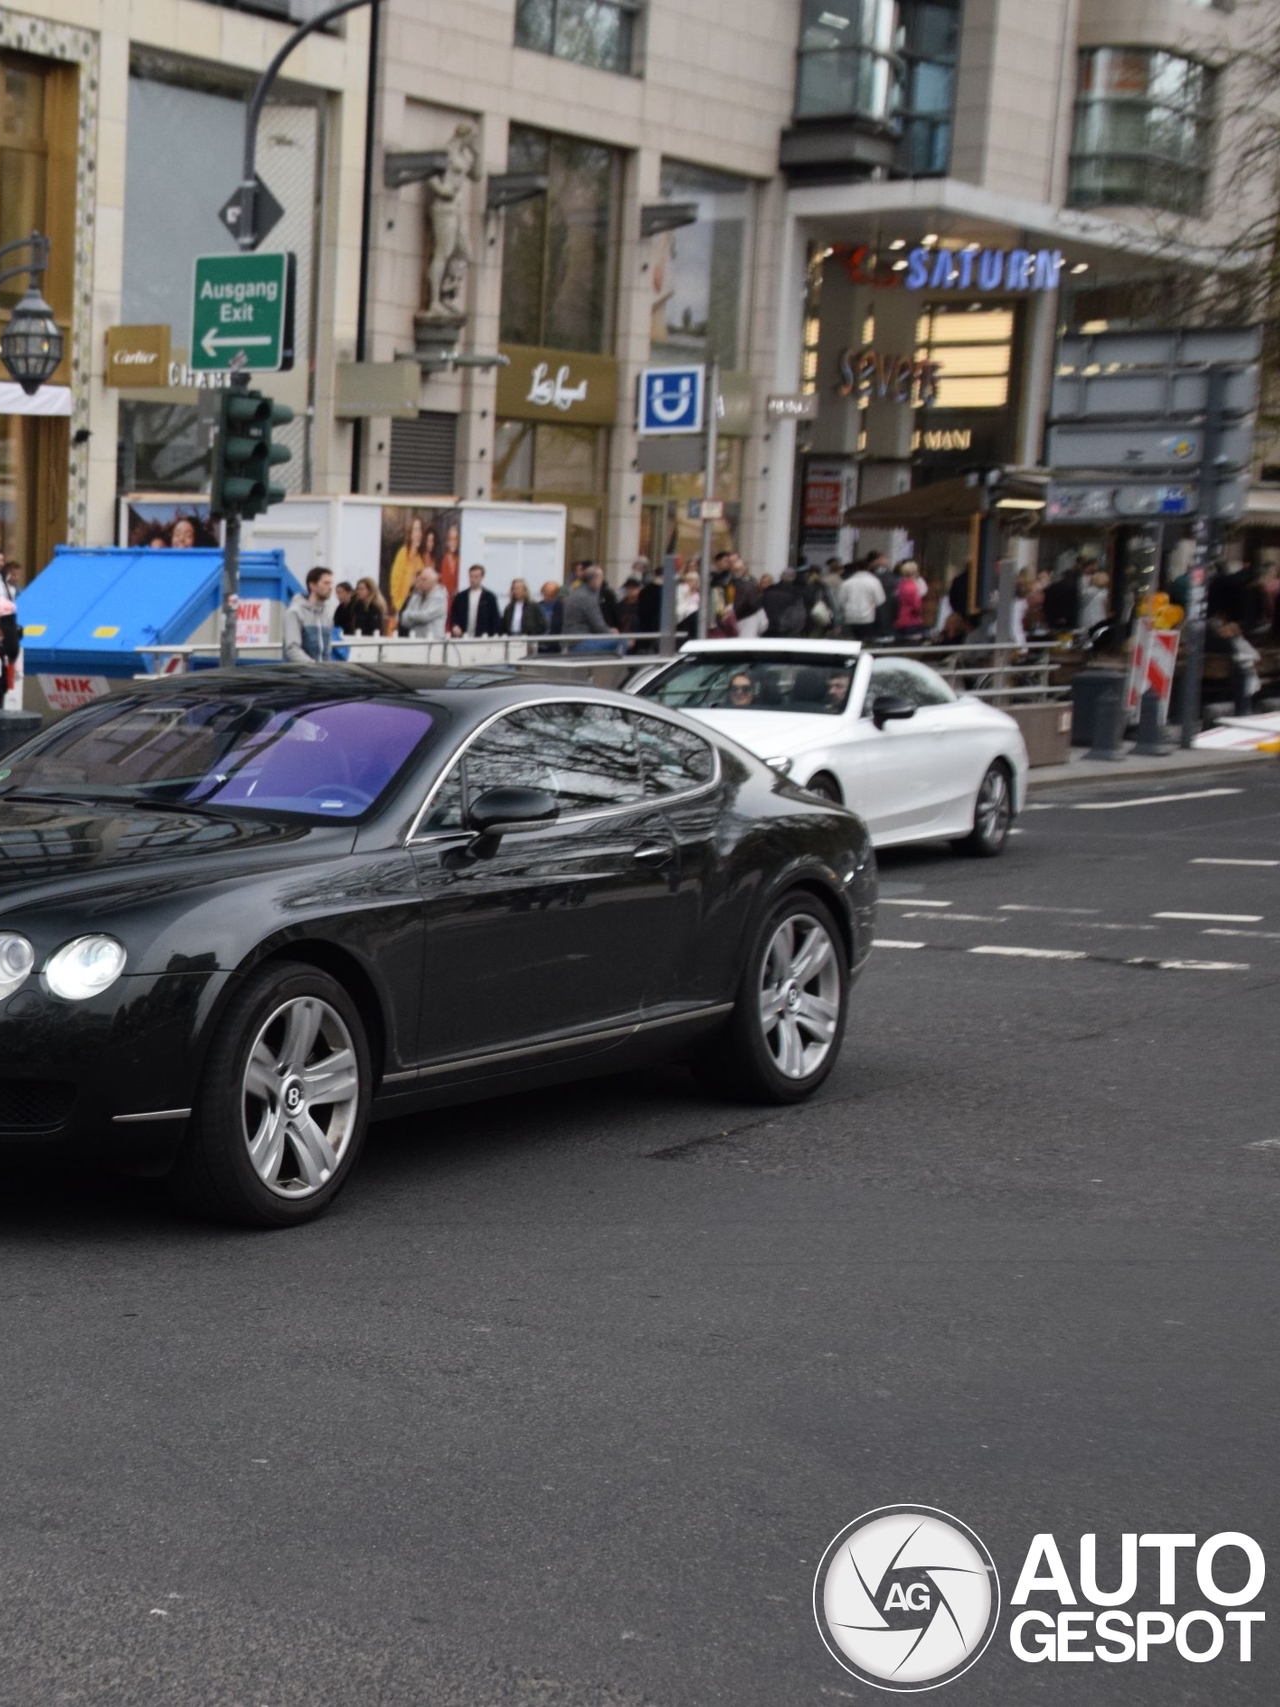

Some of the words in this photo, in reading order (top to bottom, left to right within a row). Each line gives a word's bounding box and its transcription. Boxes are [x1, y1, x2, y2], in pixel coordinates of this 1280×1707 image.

[904, 247, 1062, 291] SATURN
[200, 280, 278, 302] Ausgang
[220, 304, 254, 322] Exit
[112, 349, 158, 365] Cartier
[652, 377, 691, 422] U
[237, 603, 262, 621] NIK
[54, 677, 94, 693] NIK
